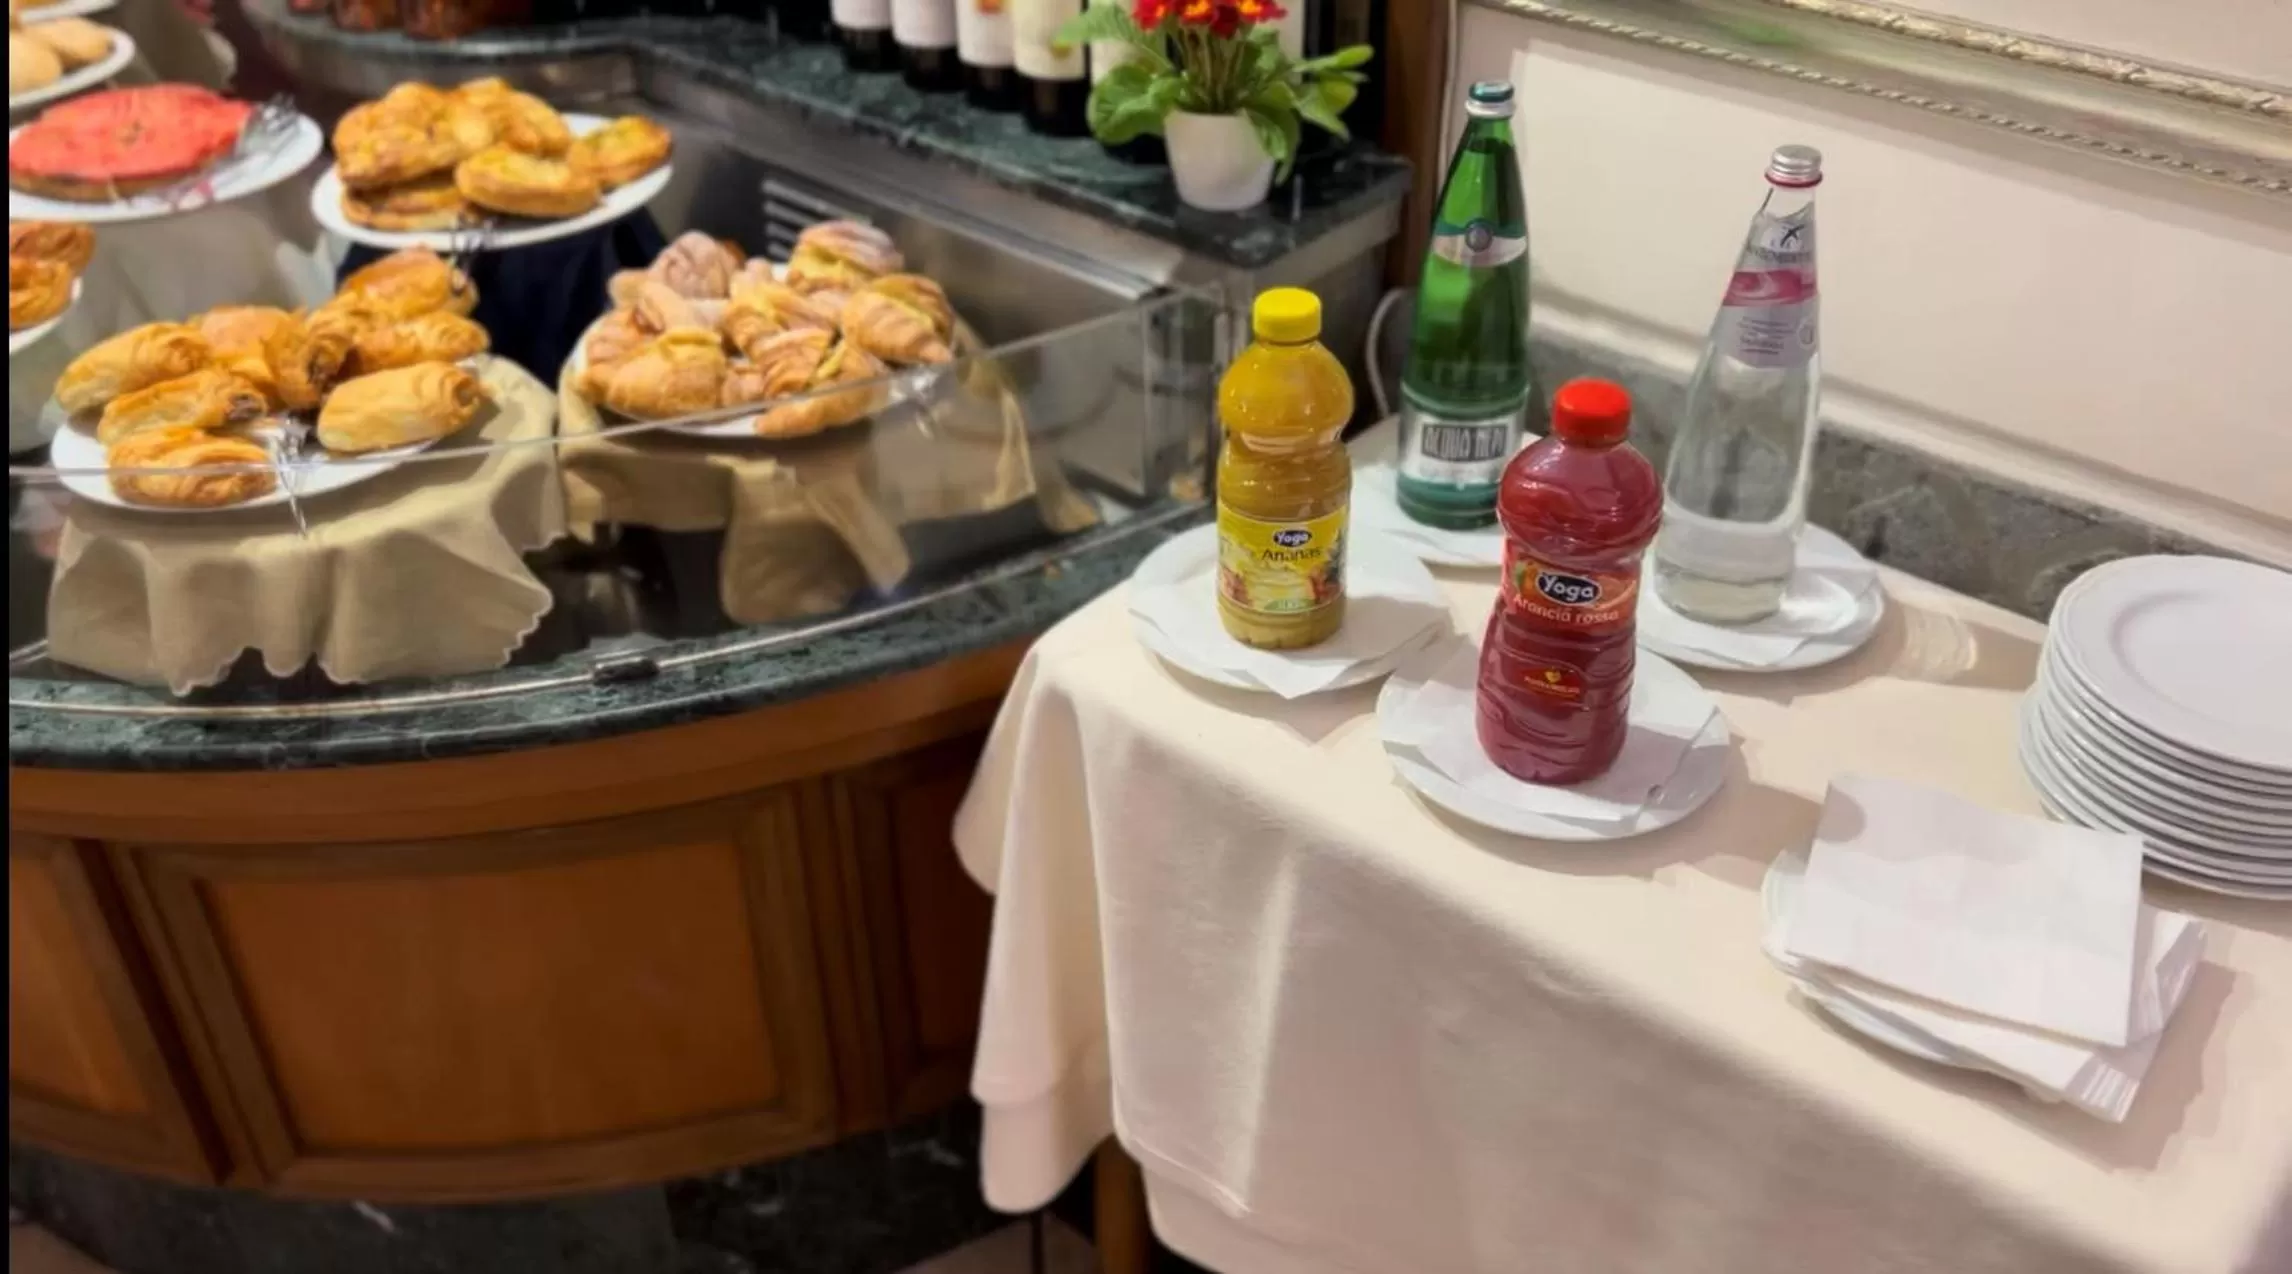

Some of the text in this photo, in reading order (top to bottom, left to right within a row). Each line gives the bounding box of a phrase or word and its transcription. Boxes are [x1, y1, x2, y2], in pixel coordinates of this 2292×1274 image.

[1277, 530, 1310, 547] Yoga
[1261, 547, 1321, 562] Ananas
[1543, 574, 1595, 602] Yoga
[1512, 594, 1620, 624] Arancia rossa
